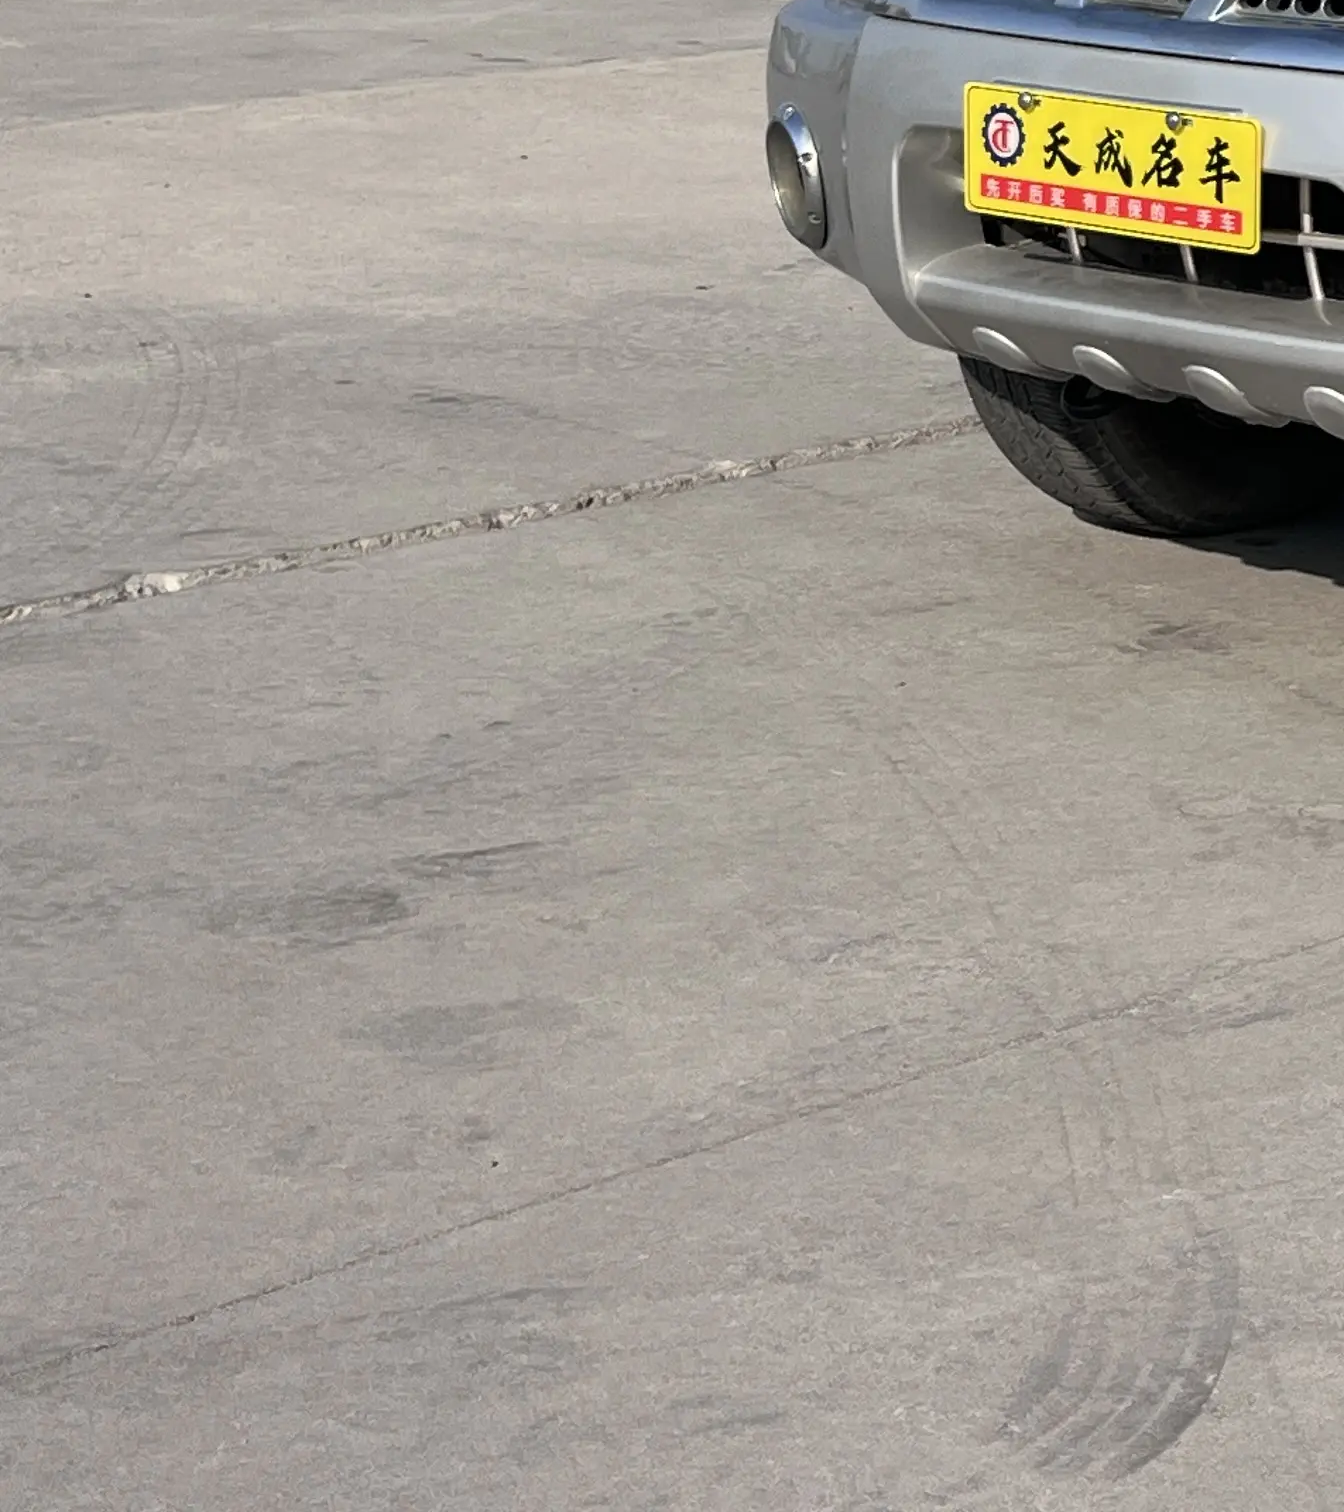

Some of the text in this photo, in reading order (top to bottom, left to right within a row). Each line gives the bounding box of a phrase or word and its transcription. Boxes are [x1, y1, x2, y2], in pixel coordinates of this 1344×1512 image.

[1043, 121, 1241, 204] 天成名车
[1083, 192, 1237, 232] 有质保的二手车
